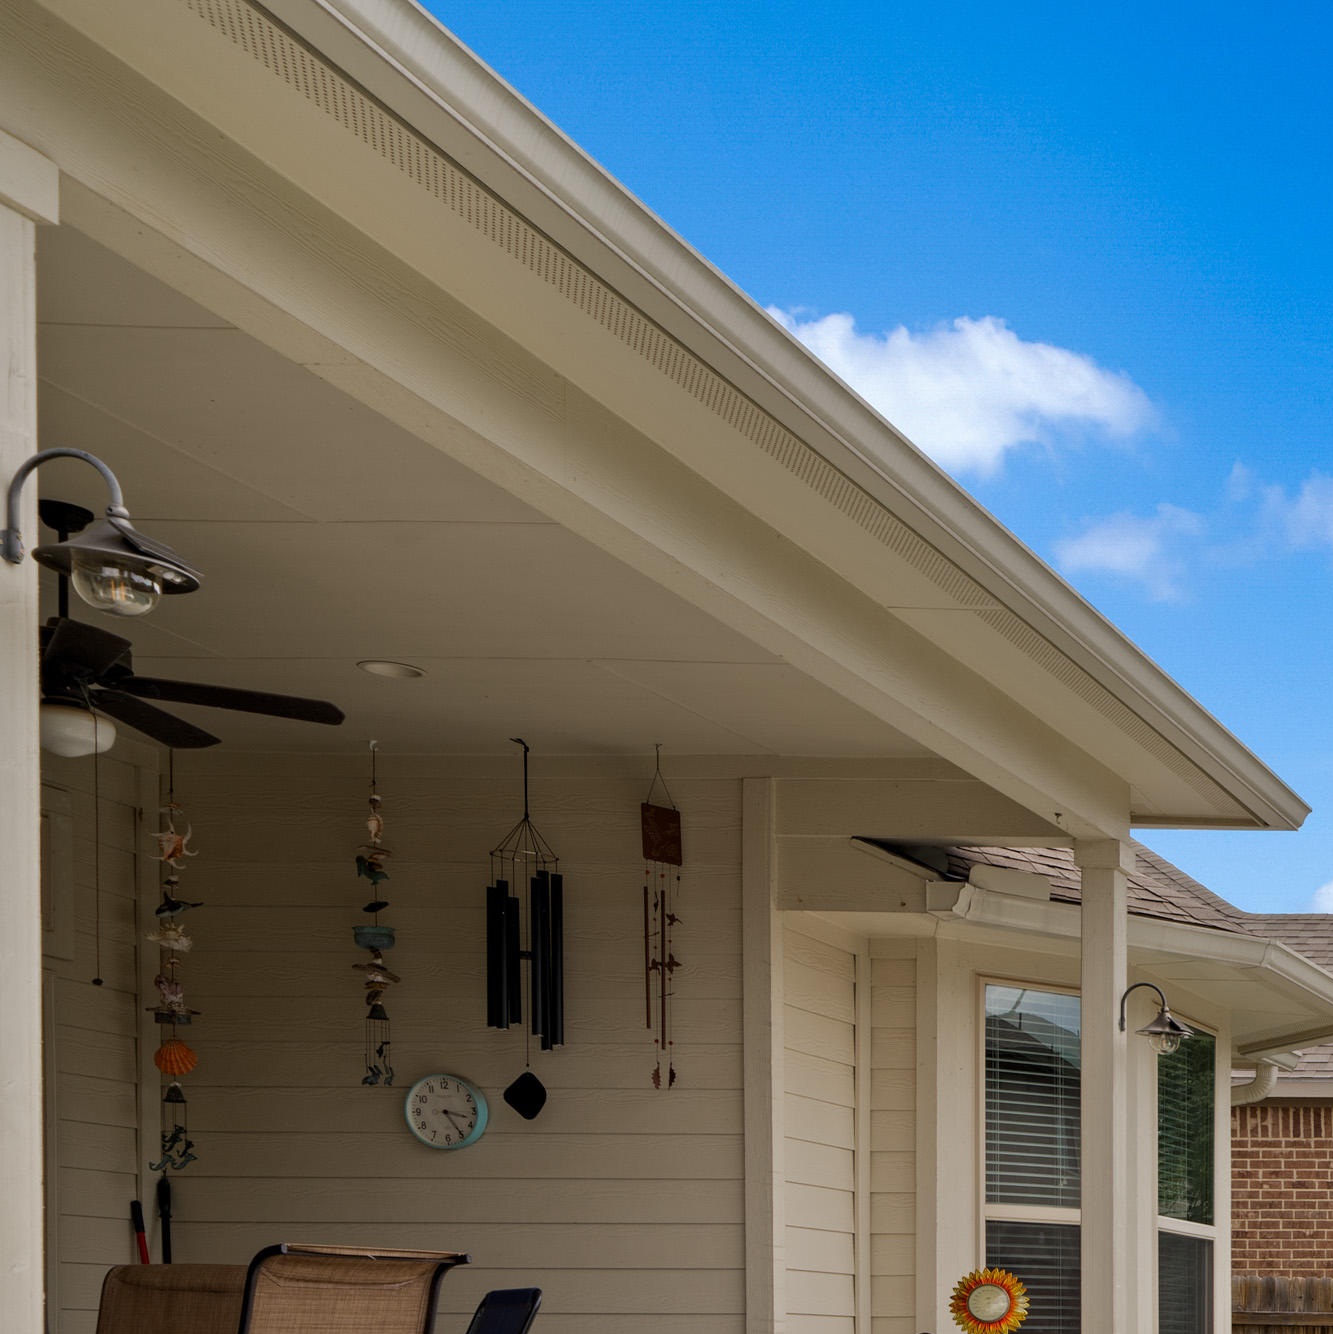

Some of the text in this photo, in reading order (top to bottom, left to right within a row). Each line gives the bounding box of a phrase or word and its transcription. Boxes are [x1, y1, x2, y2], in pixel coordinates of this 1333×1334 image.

[428, 1085, 434, 1094] 11
[440, 1081, 448, 1090] 12
[457, 1085, 460, 1093] 1
[419, 1095, 427, 1103] 10
[466, 1094, 472, 1102] 2
[415, 1108, 421, 1116] 9
[471, 1107, 477, 1115] 3
[421, 1121, 427, 1130] 8
[468, 1121, 473, 1129] 4
[432, 1131, 437, 1139] 7
[445, 1134, 451, 1142] 6
